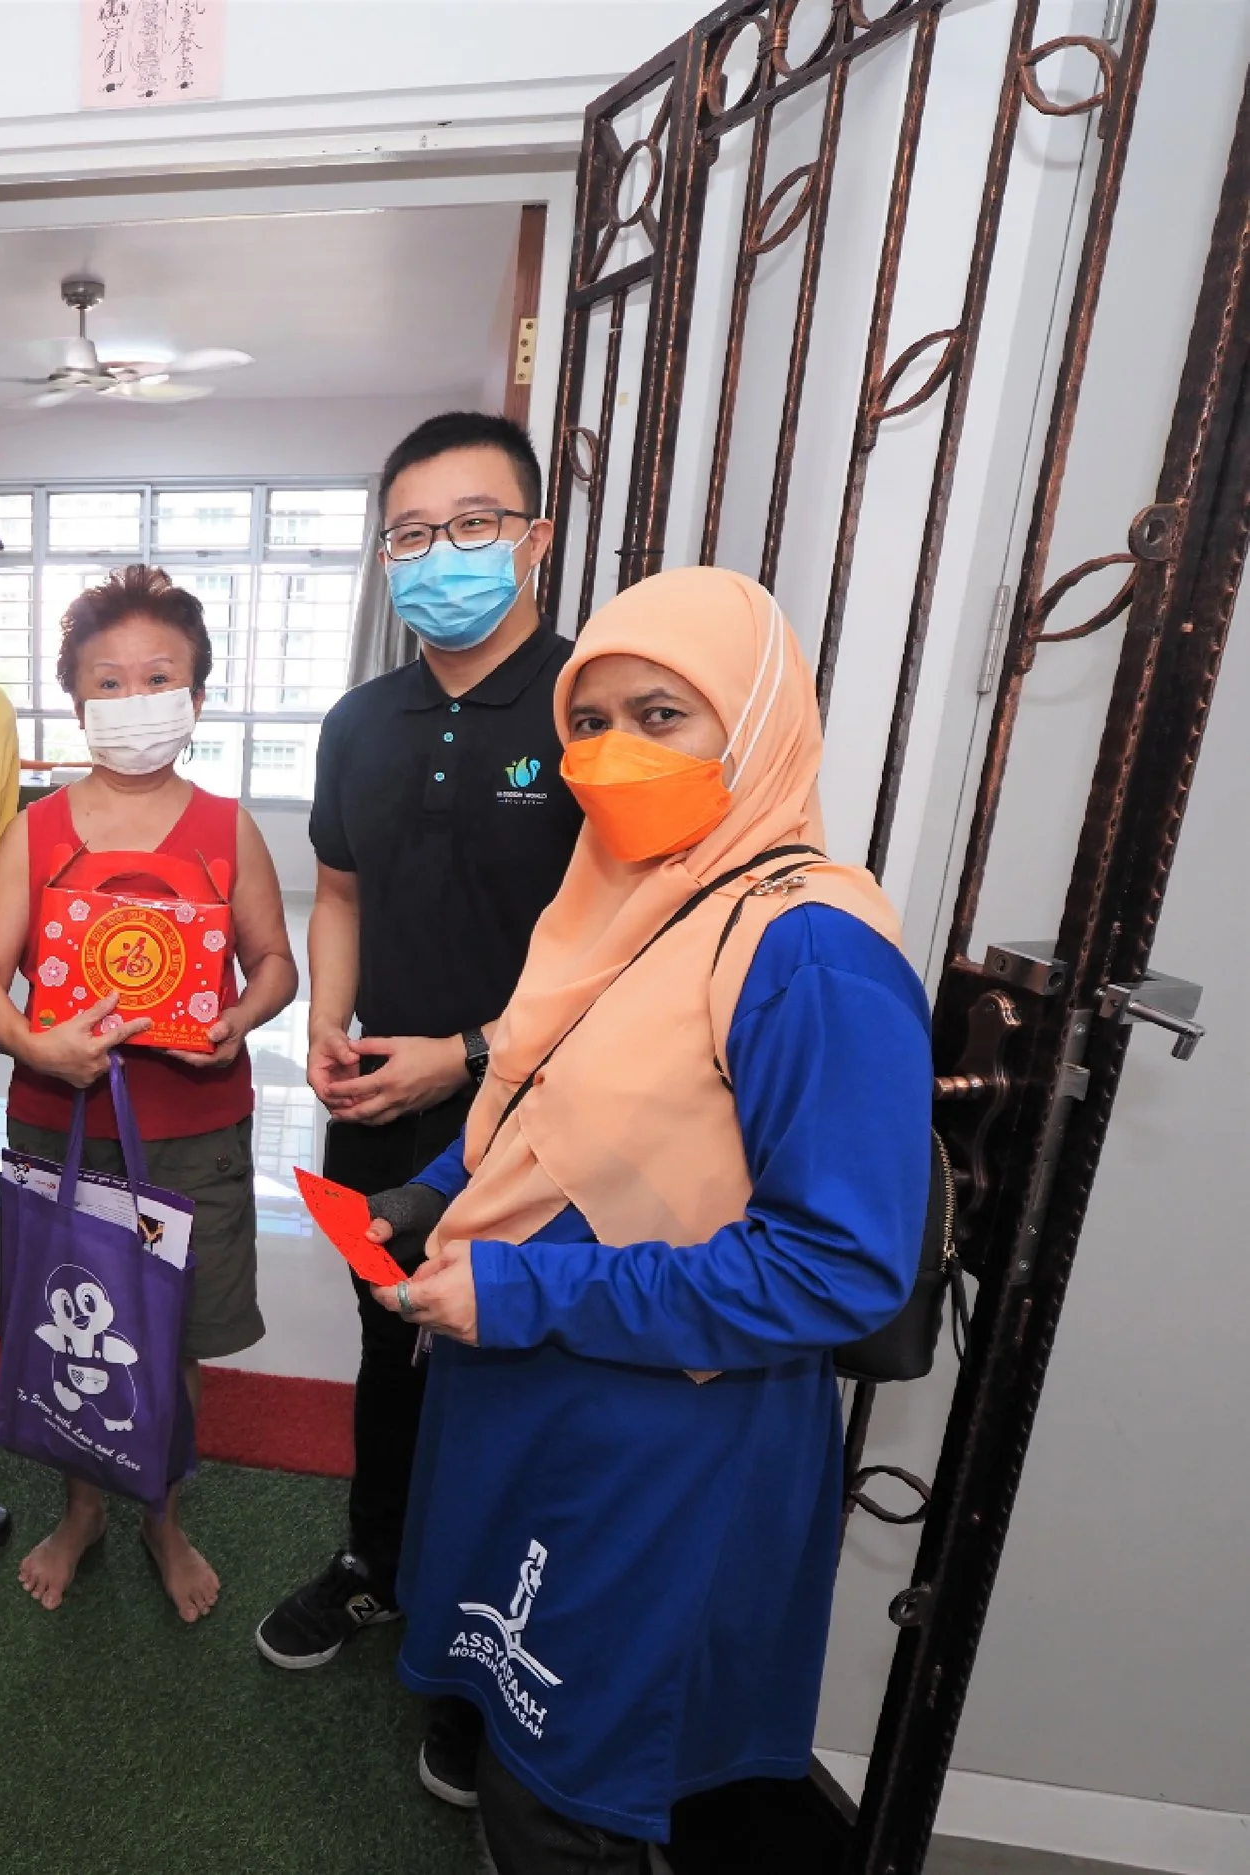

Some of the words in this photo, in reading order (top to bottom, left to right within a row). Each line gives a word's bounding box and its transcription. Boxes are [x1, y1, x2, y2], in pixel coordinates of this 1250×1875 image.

[55, 1413, 72, 1429] with
[72, 1428, 93, 1445] Love
[95, 1444, 116, 1457] and
[116, 1453, 141, 1471] Care
[448, 1647, 498, 1676] MOSQUE
